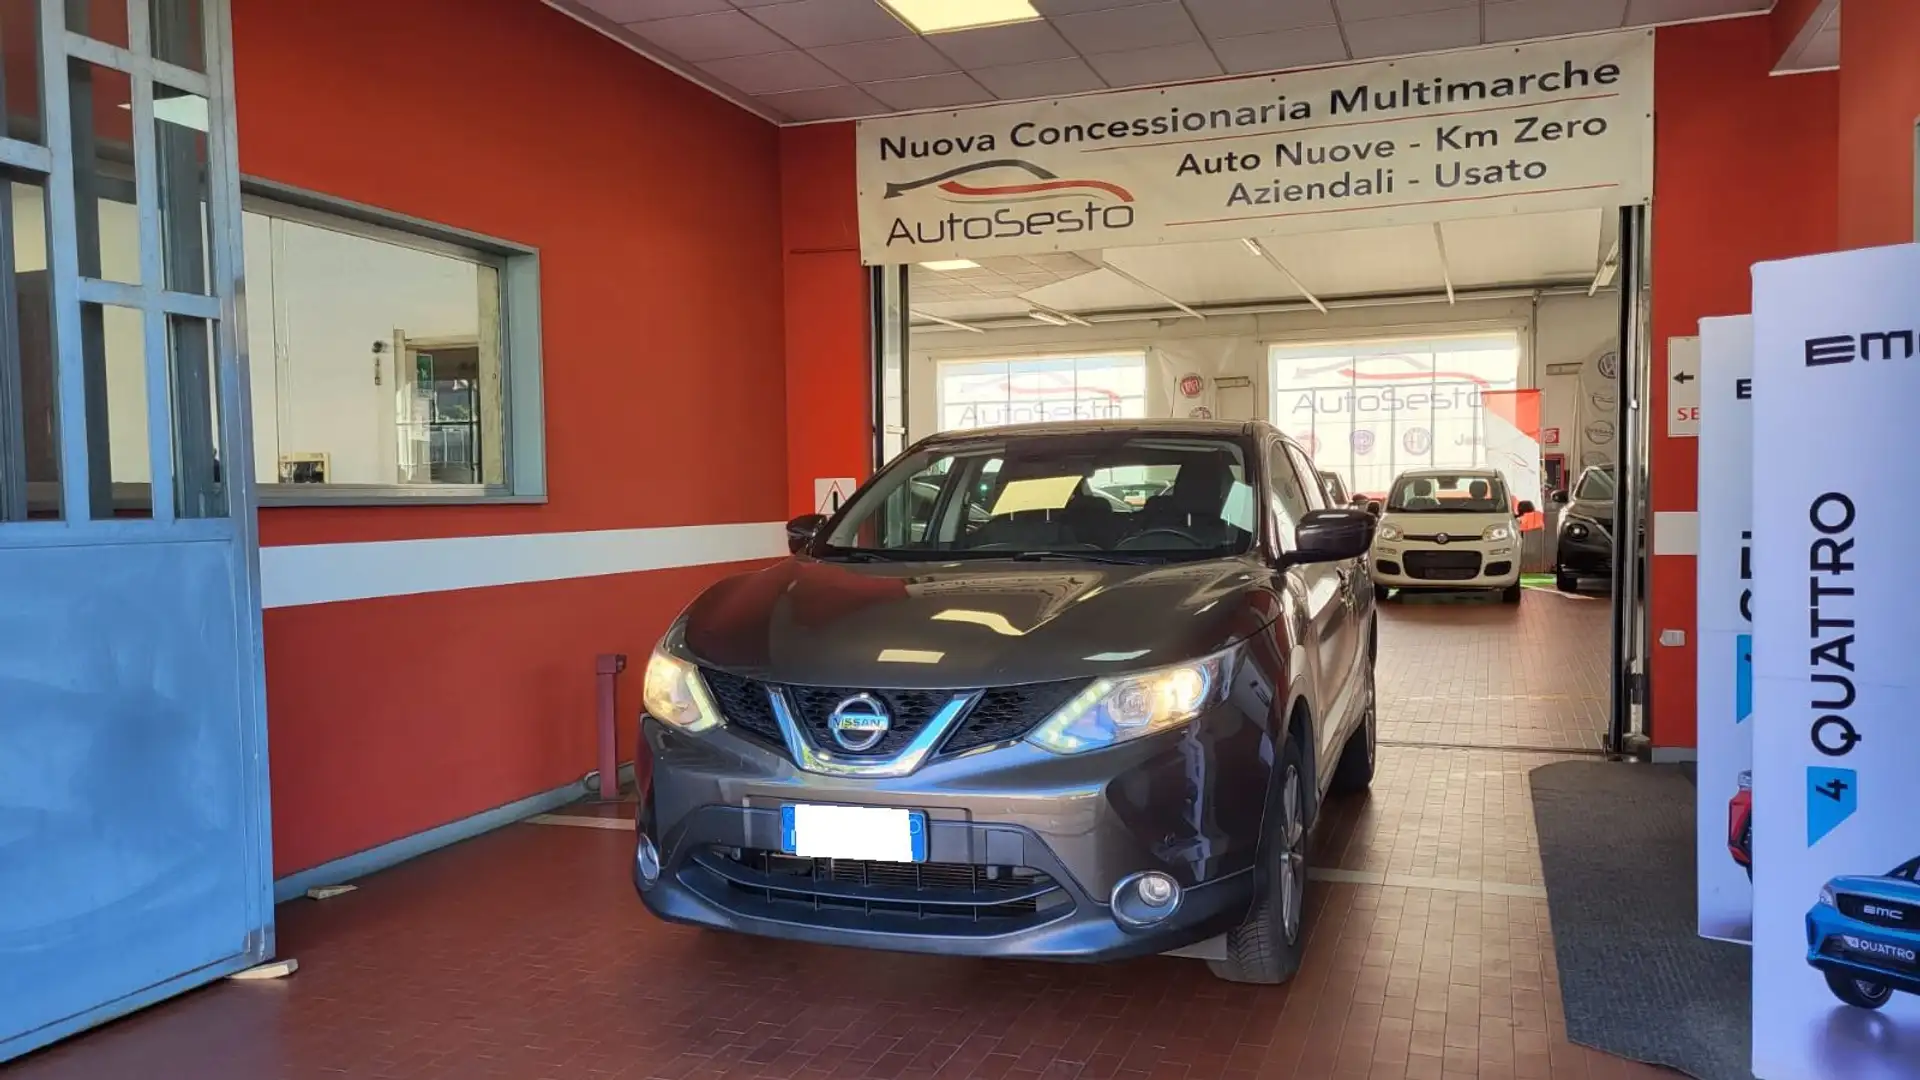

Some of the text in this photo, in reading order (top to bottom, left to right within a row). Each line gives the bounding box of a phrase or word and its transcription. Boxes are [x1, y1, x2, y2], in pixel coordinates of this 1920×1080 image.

[880, 60, 1621, 160] Nuova Concessionaria Multimarche
[1176, 151, 1261, 177] Auto
[1276, 138, 1395, 167] Nuove
[1436, 124, 1498, 152] Km
[1514, 115, 1607, 144] Zero
[1226, 168, 1394, 206] Aziendali
[1435, 158, 1547, 188] Usato
[886, 201, 1134, 247] AutoSesto
[1805, 330, 1920, 367] EM
[1809, 492, 1862, 802] 4 QUATTRO
[832, 717, 881, 728] NISSAN
[1860, 940, 1916, 961] QUATTRO
